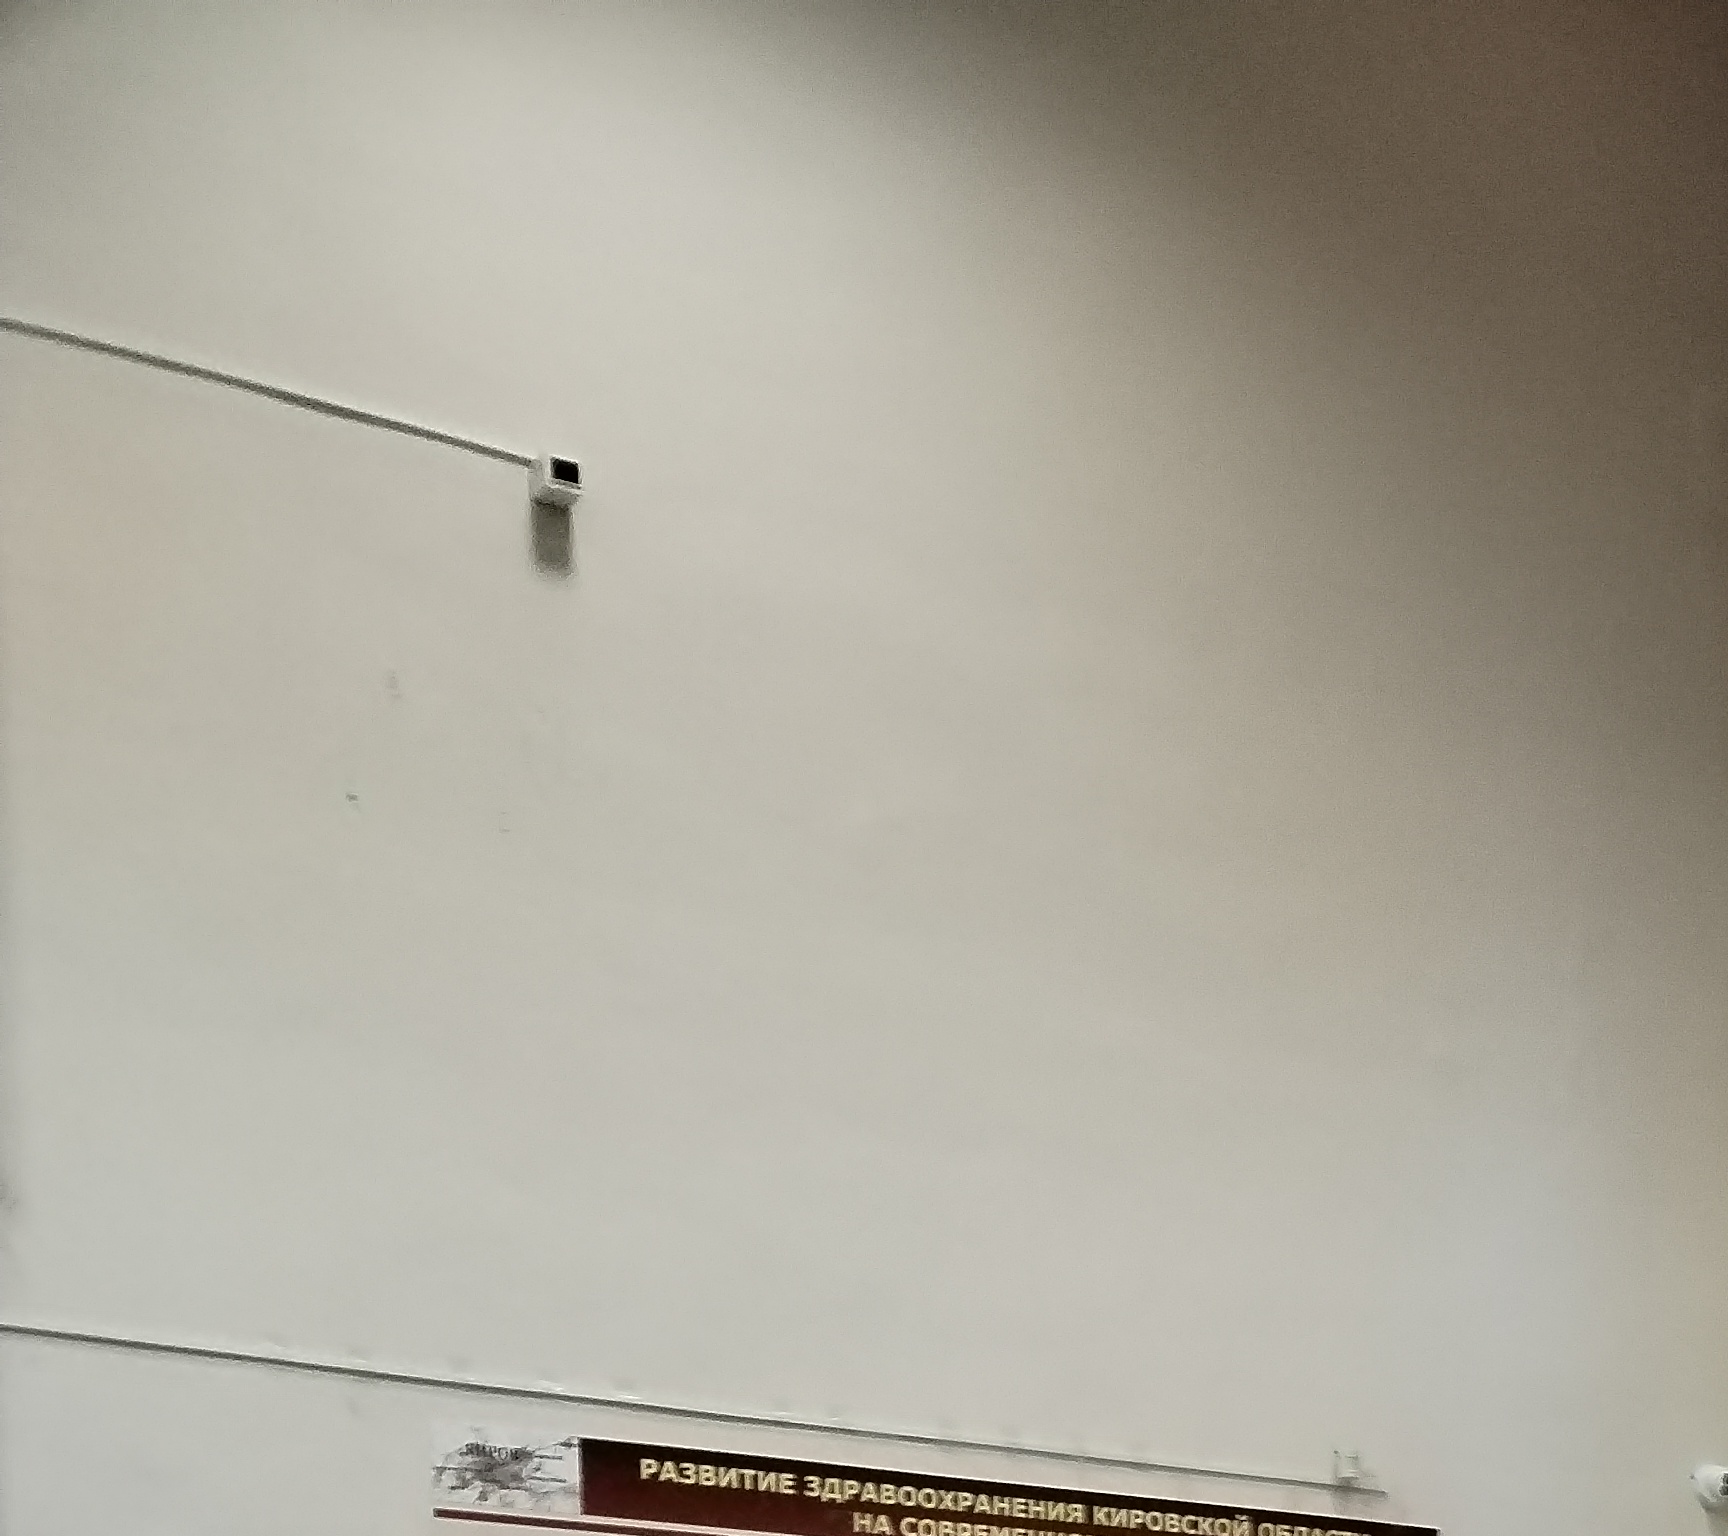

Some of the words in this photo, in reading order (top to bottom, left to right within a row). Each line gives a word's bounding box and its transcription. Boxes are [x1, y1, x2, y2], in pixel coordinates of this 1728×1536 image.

[638, 1457, 798, 1496] РАЗВИТИЕ
[803, 1474, 1087, 1524] ЗДРАВООХРАНЕНИЯ
[852, 1510, 894, 1536] НА
